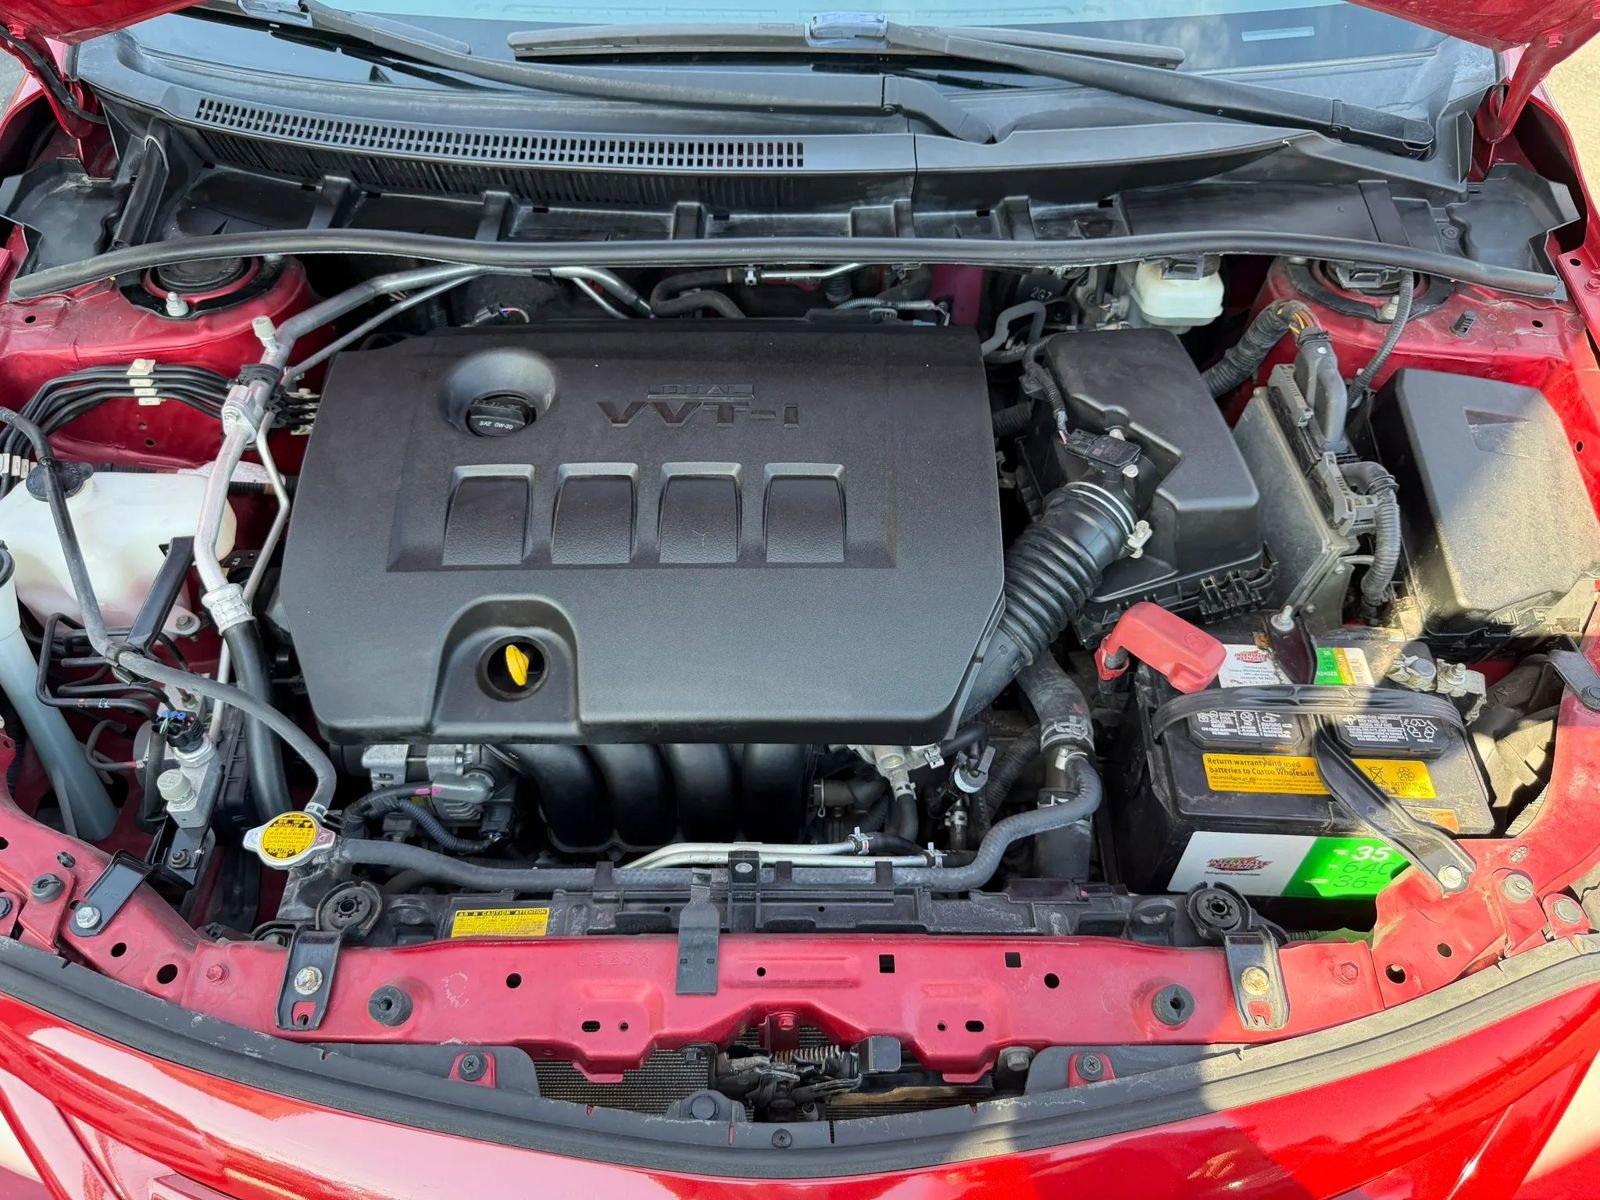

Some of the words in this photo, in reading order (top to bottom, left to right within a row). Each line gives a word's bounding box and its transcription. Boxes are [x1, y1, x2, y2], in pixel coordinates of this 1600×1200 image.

[494, 422, 514, 430] 0W-20
[1233, 760, 1266, 768] warranty
[1283, 760, 1301, 768] used
[1209, 766, 1241, 774] batteries
[1252, 767, 1276, 776] Costco
[1276, 767, 1315, 777] Wholesale
[1352, 845, 1392, 861] 35
